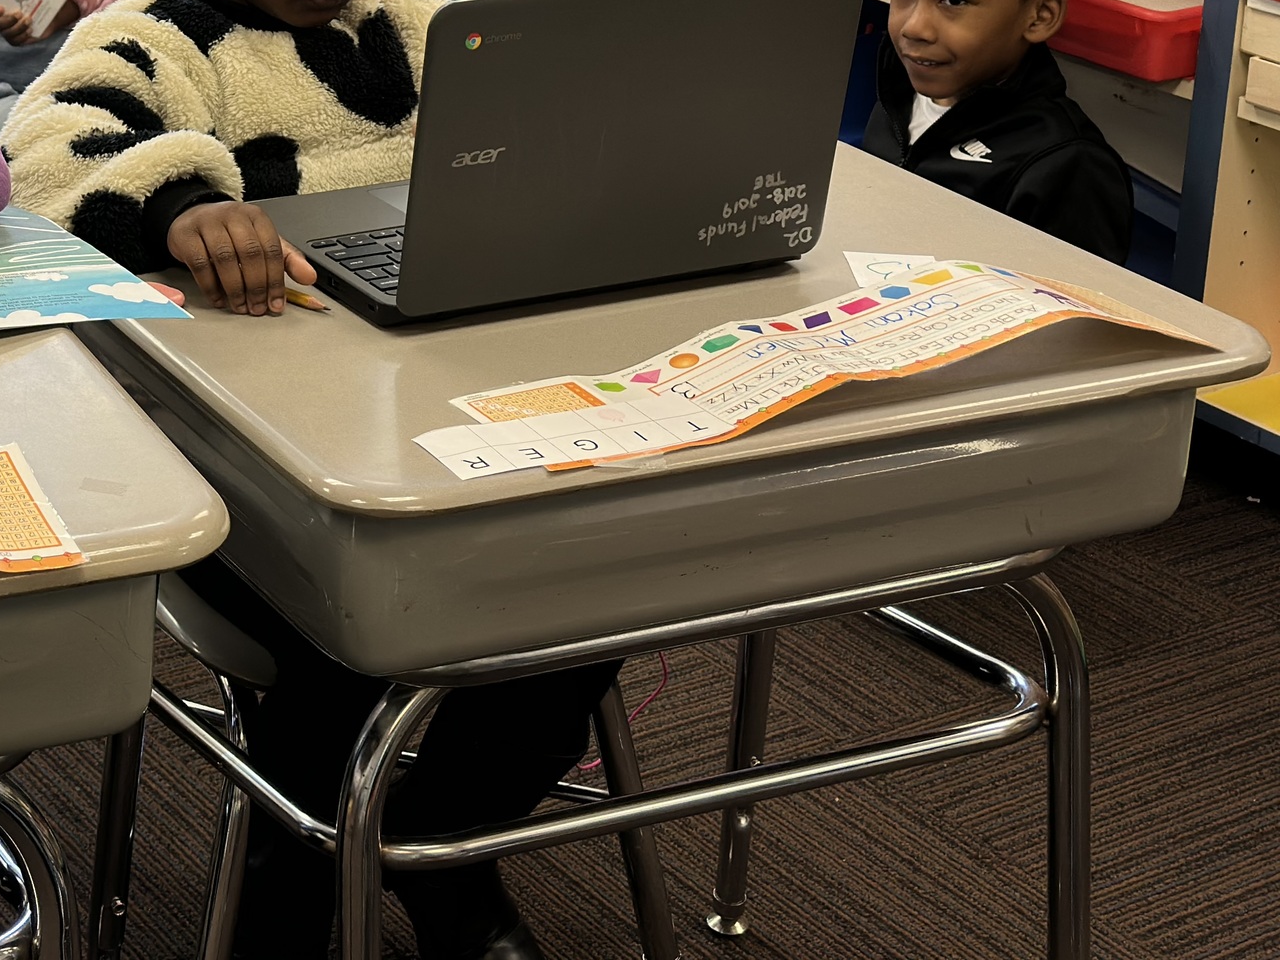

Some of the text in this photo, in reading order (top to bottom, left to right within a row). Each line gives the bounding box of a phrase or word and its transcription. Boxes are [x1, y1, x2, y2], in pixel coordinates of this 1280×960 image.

[485, 33, 522, 44] chrome
[452, 147, 506, 167] acer
[698, 204, 808, 246] Federal Funds
[784, 227, 812, 247] D2
[707, 294, 1021, 404] Nn Oo Pp Qq Rr Ss Xx Yy Zz
[726, 304, 1037, 414] Aa Bb Cc Dd Ee Ff Gg Jj Kk Ll Mm
[687, 420, 709, 433] T
[573, 439, 599, 451] G
[462, 455, 491, 470] R
[518, 447, 545, 461] E
